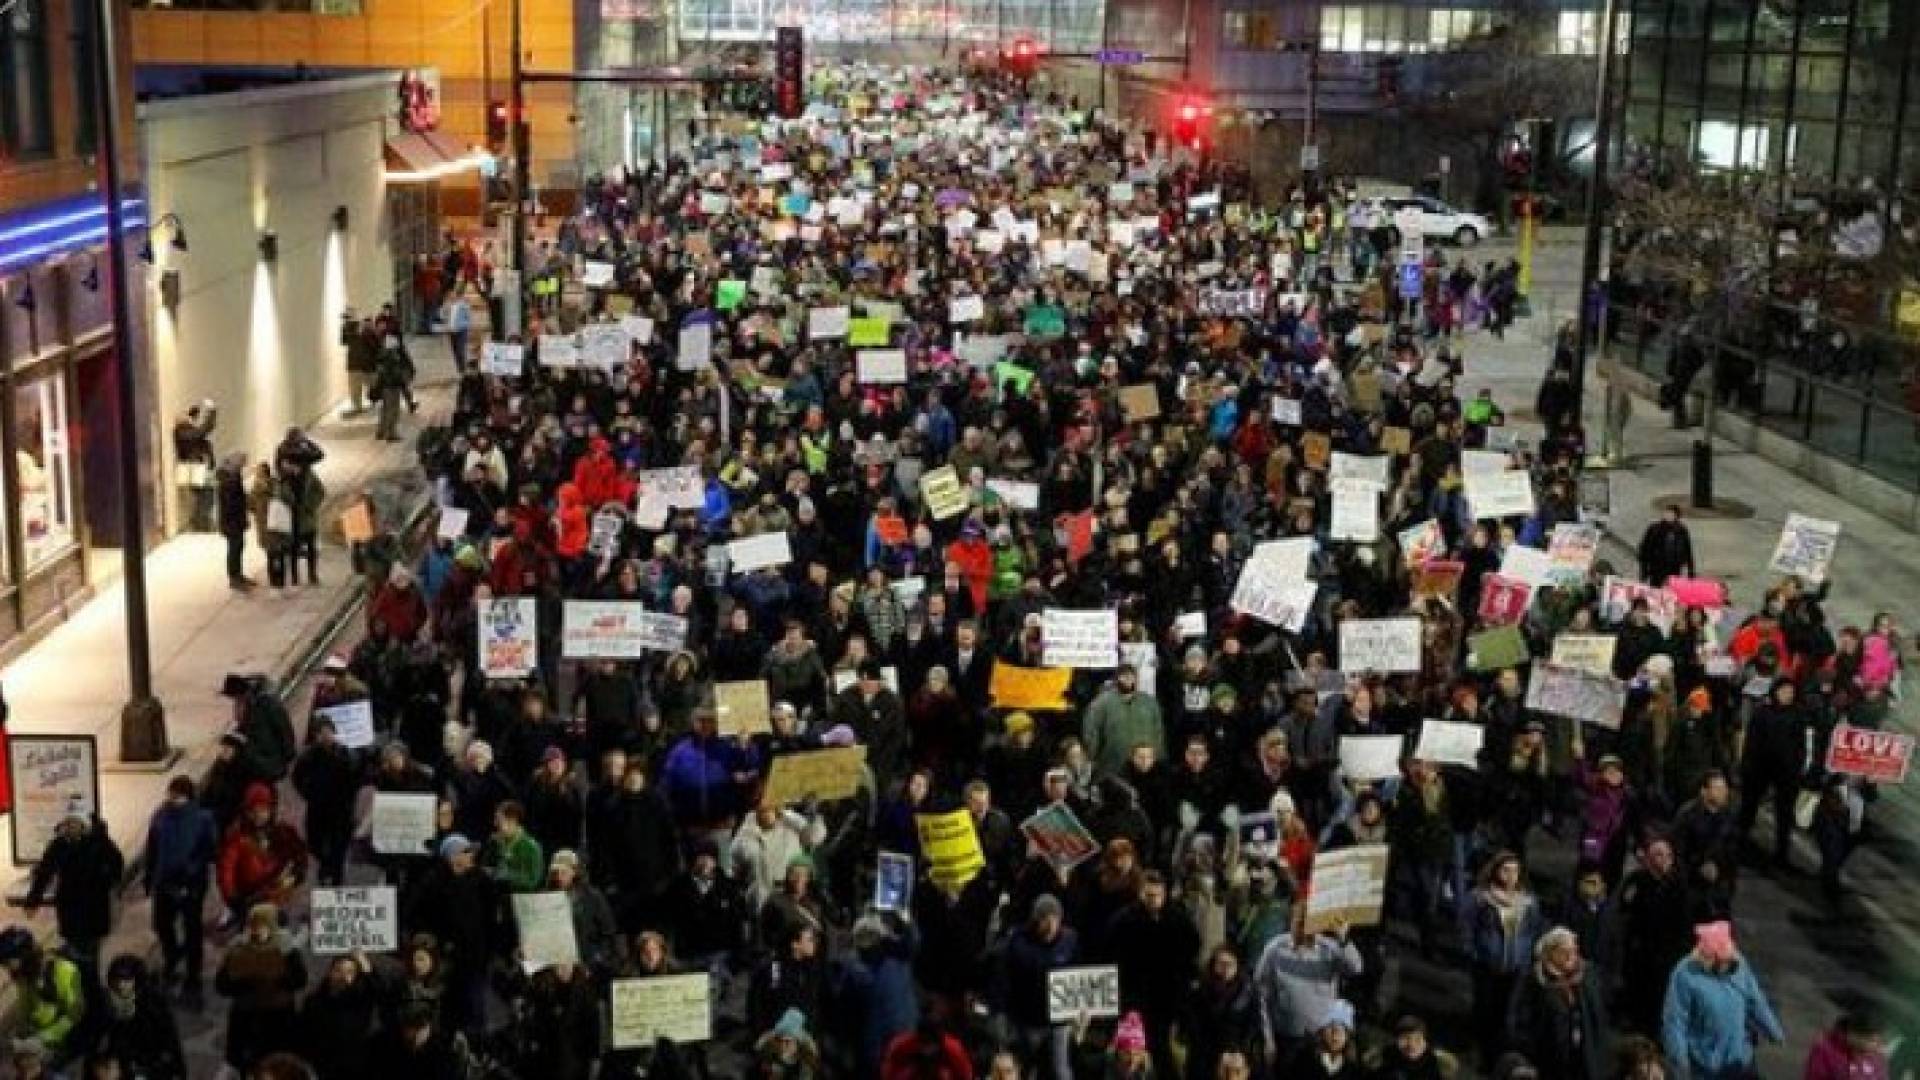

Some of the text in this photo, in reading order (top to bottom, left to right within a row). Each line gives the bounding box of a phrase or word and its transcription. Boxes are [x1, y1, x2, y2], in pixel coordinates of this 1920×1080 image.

[1837, 730, 1906, 761] LOVE
[336, 889, 369, 903] THE
[313, 905, 387, 921] PEOPLE
[317, 933, 387, 949] PREVAIL
[1052, 972, 1118, 1012] SHAME
